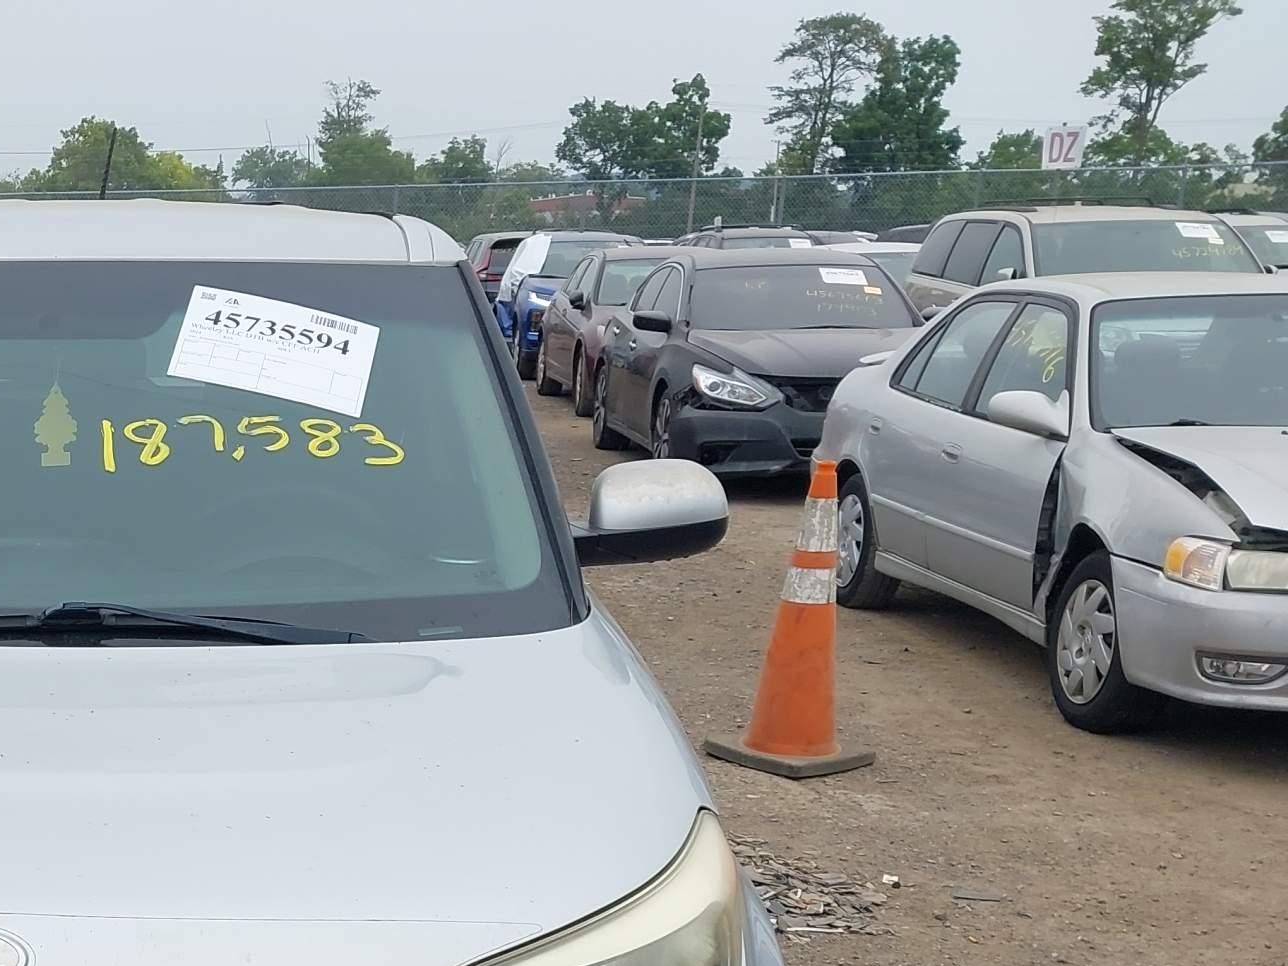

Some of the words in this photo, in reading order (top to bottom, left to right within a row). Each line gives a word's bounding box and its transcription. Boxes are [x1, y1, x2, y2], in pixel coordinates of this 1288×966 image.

[1048, 131, 1080, 163] DZ
[204, 309, 351, 356] 45735594
[101, 415, 405, 473] 187,583
